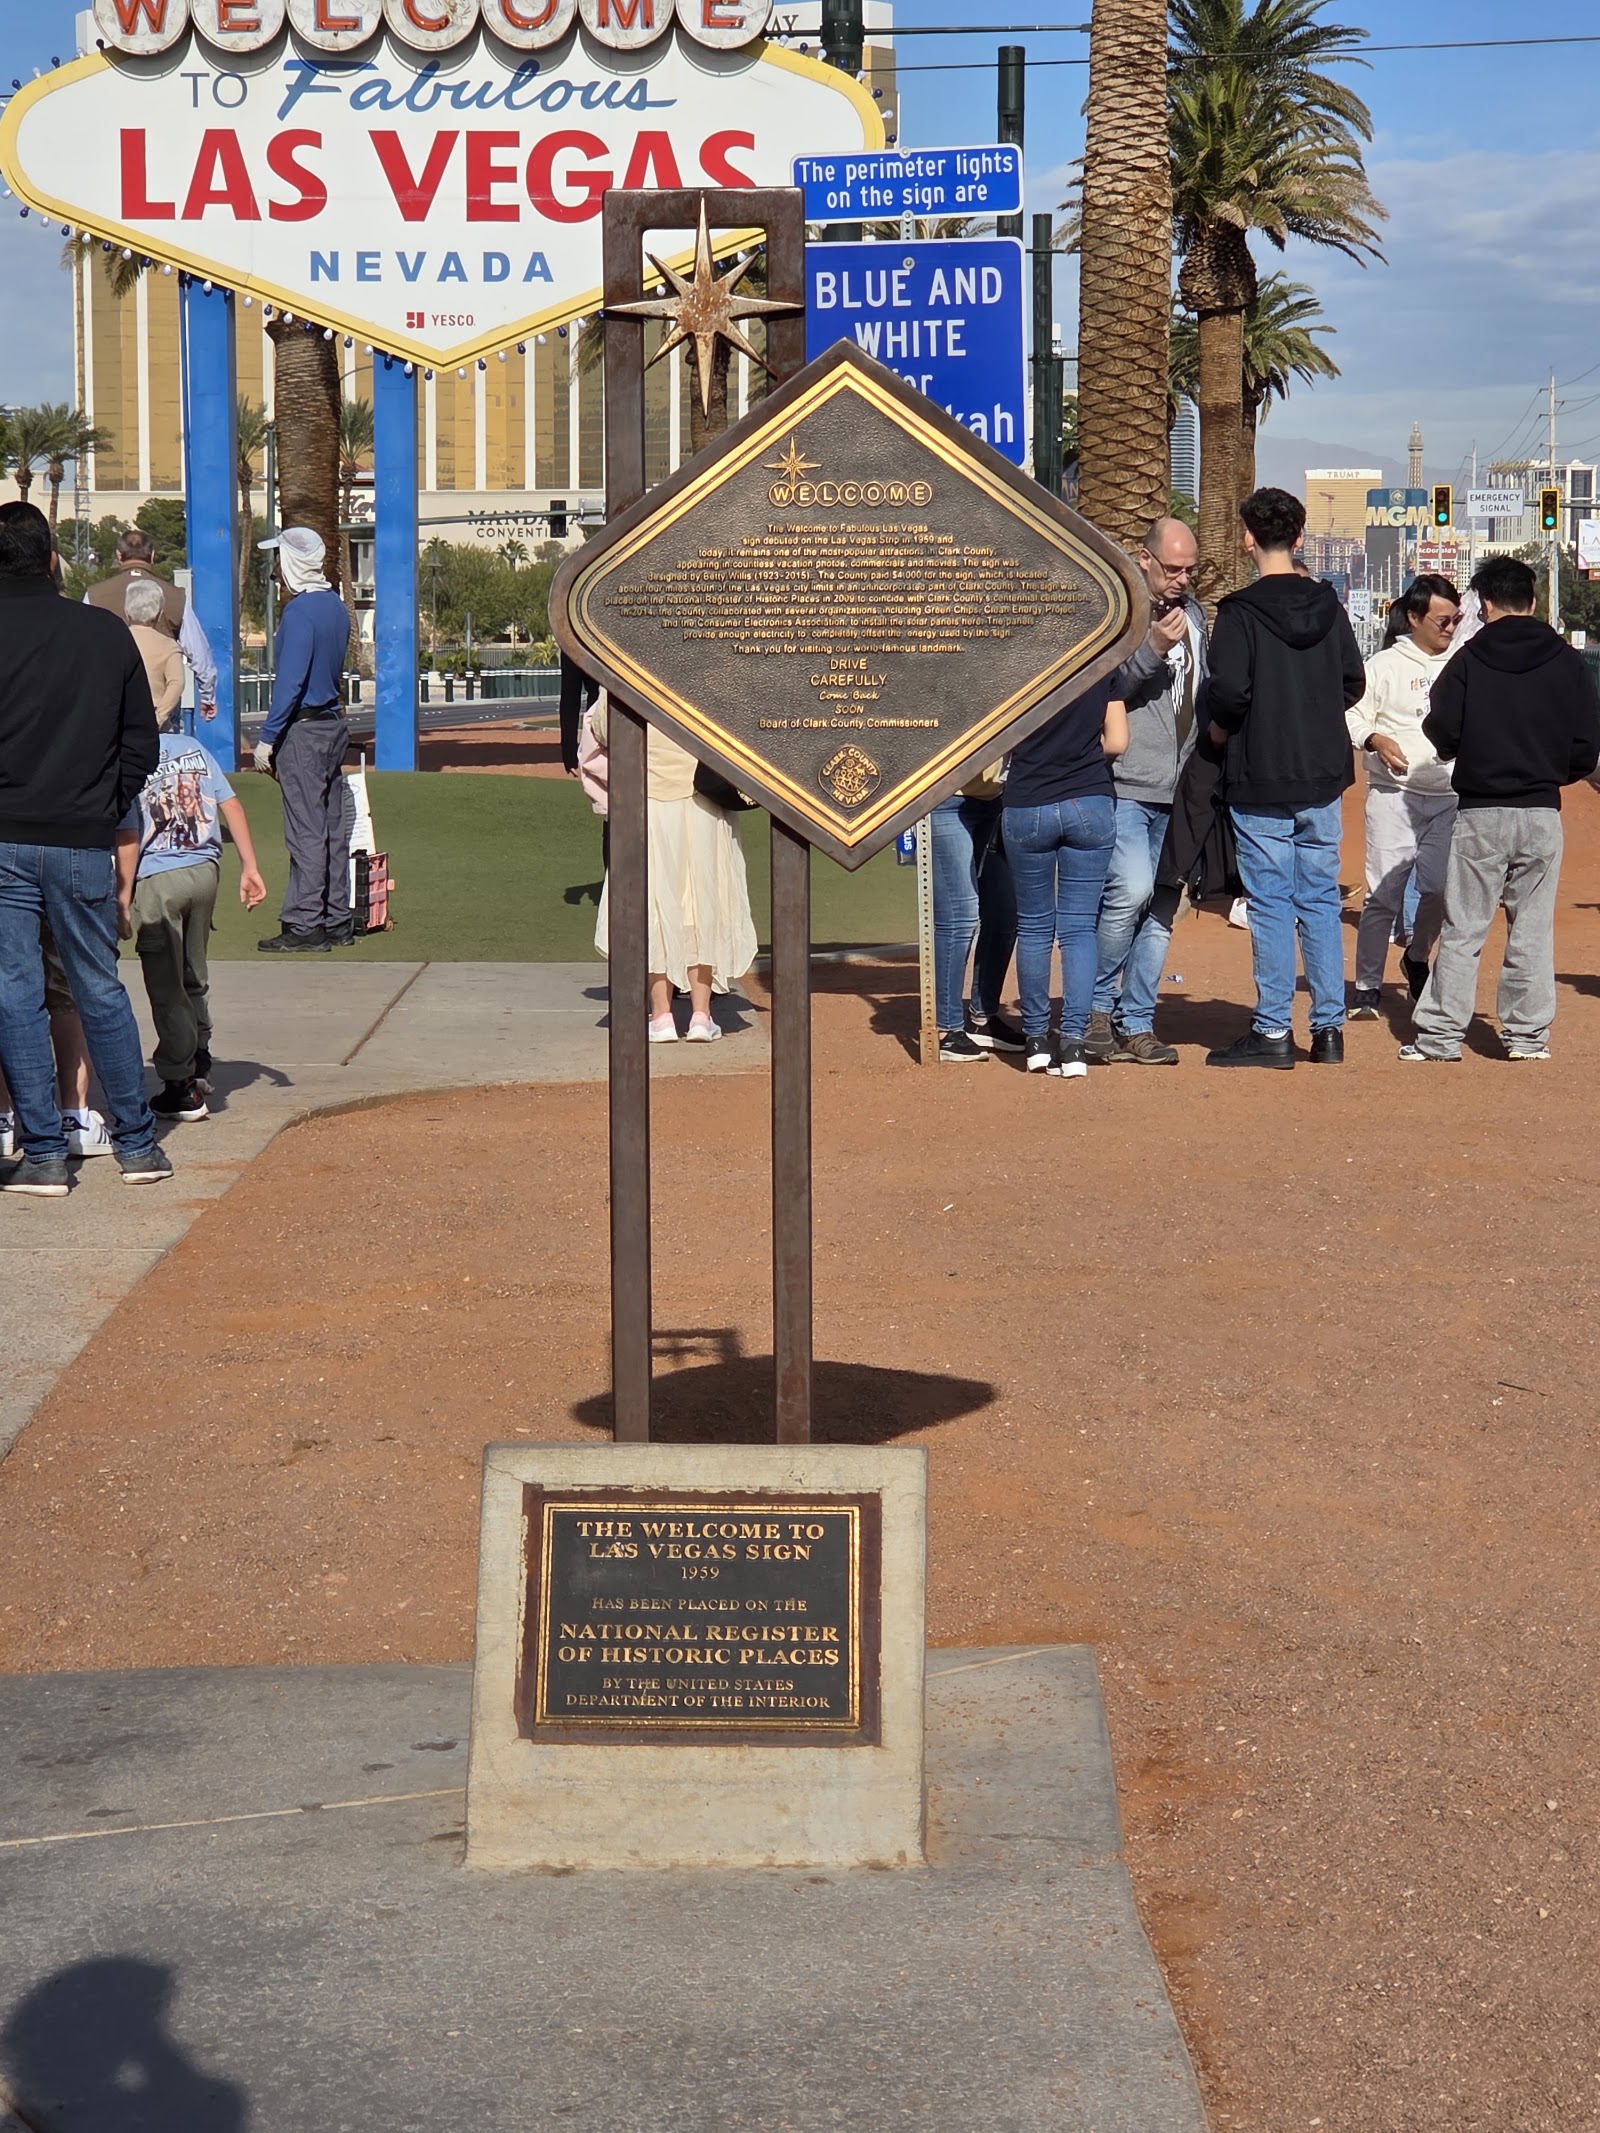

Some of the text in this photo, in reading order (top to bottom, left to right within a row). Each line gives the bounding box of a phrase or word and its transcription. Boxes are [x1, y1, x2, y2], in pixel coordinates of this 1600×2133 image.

[115, 0, 747, 36] WELCOME
[180, 59, 678, 122] TO Fabulous
[120, 128, 757, 223] LAS VEGAS
[799, 153, 1014, 187] The perimeter lights
[826, 183, 988, 210] on the sign are
[310, 250, 554, 282] NEVADA
[816, 266, 1002, 309] BLUE AND
[856, 319, 966, 358] WHITE
[772, 484, 927, 502] WELCOME
[1470, 494, 1520, 502] EMERGENCY
[1480, 504, 1512, 512] SIGNAL
[1366, 506, 1428, 526] MGM
[767, 524, 928, 534] The Welcome to Fabulous Las Vegas
[742, 536, 761, 547] sign
[763, 536, 798, 545] debuted
[814, 536, 828, 545] the
[830, 536, 847, 544] Las
[850, 536, 877, 546] Vegas
[902, 536, 910, 544] in
[913, 536, 935, 544] 1959
[937, 536, 954, 544] and
[736, 548, 771, 557] remains
[792, 548, 802, 556] of
[803, 548, 817, 556] the
[819, 548, 877, 558] most-popular
[938, 547, 960, 556] Clark
[676, 560, 720, 571] appearing
[722, 560, 730, 569] in
[732, 560, 774, 569] countless
[776, 560, 813, 568] vacation
[850, 560, 905, 568] commercials
[907, 560, 924, 568] and
[962, 559, 979, 568] The
[981, 559, 1000, 570] sign
[689, 572, 701, 583] by
[728, 572, 752, 580] Willis
[817, 572, 835, 580] The
[837, 572, 868, 582] County
[870, 571, 889, 582] paid
[924, 571, 936, 580] for
[938, 571, 952, 580] the
[978, 571, 1003, 579] which
[745, 583, 982, 594] Las Vegas city Clark
[705, 595, 741, 606] Register
[743, 595, 753, 603] of
[755, 595, 788, 603] Historic
[792, 595, 820, 603] Places
[822, 595, 830, 603] in
[857, 594, 866, 603] to
[868, 594, 904, 603] coincide
[907, 594, 925, 603] with
[927, 594, 950, 603] Clark
[764, 606, 951, 617] with several including Green
[697, 618, 959, 629] Consumer Electronics to solar panels
[718, 631, 751, 642] enough
[797, 631, 806, 639] to
[906, 631, 936, 640] energy
[939, 630, 960, 638] used
[963, 630, 973, 640] by
[764, 646, 781, 656] you
[784, 645, 797, 654] for
[800, 645, 832, 655] visiting
[830, 658, 868, 670] DRIVE
[810, 674, 886, 686] CAREFULLY
[819, 691, 880, 700] Come Back
[834, 706, 864, 714] SOON
[760, 718, 939, 730] Board of Clark County Commissioners
[822, 749, 878, 776] CLARK COUNTY
[833, 789, 869, 804] NEVADA
[576, 1522, 824, 1540] THE WELCOME TO
[589, 1542, 812, 1561] LAS VEGAS SIGN
[682, 1566, 720, 1580] 1959
[592, 1598, 808, 1612] HAS BEEN PLACED ON THE
[558, 1624, 840, 1642] NATIONAL REGISTER
[558, 1646, 840, 1666] OF HISTORIC PLACES
[602, 1678, 794, 1691] BY THE UNITED STATES
[566, 1694, 831, 1708] DEPARTMENT OF THE INTERIOR
